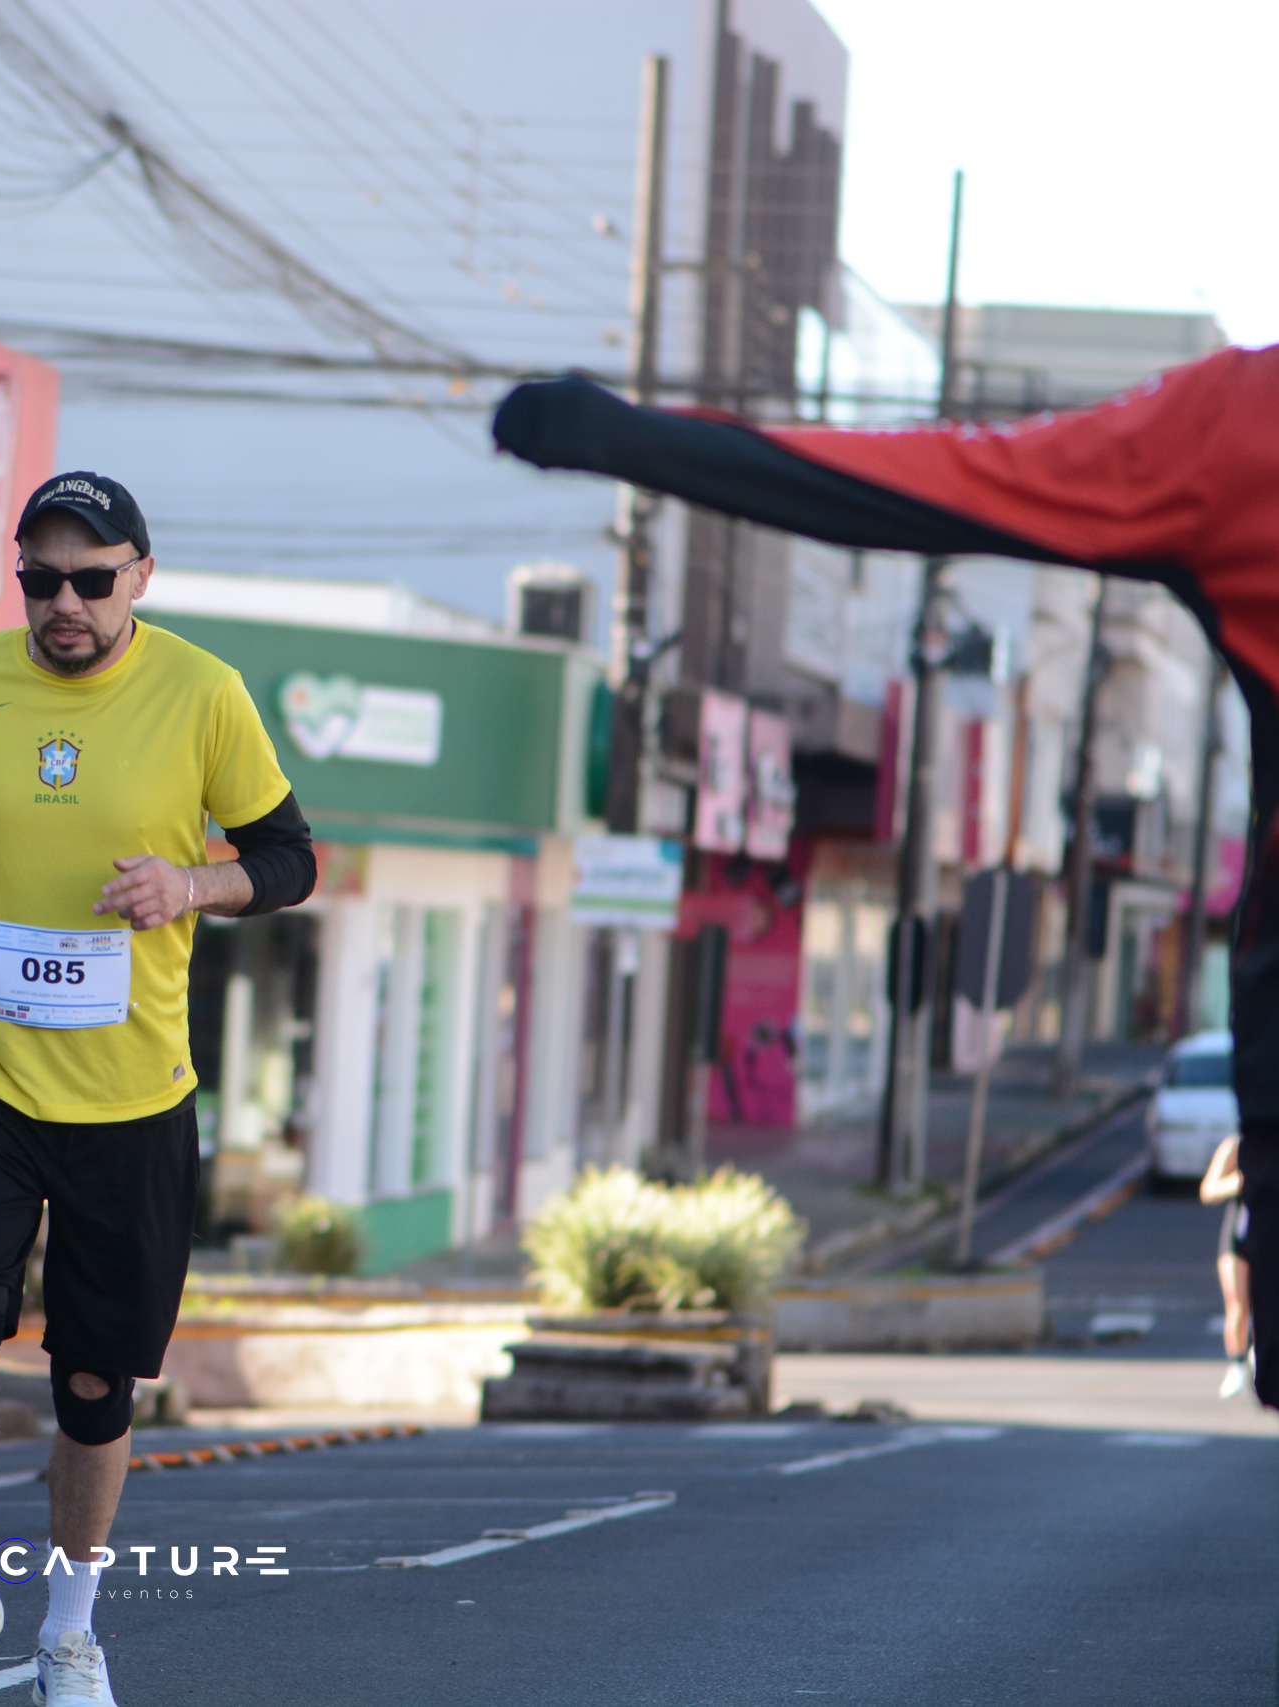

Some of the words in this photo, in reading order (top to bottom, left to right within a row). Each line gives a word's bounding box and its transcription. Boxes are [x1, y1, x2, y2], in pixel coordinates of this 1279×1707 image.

[50, 759, 67, 767] CBF
[34, 793, 79, 805] BRASIL
[21, 957, 85, 985] 085
